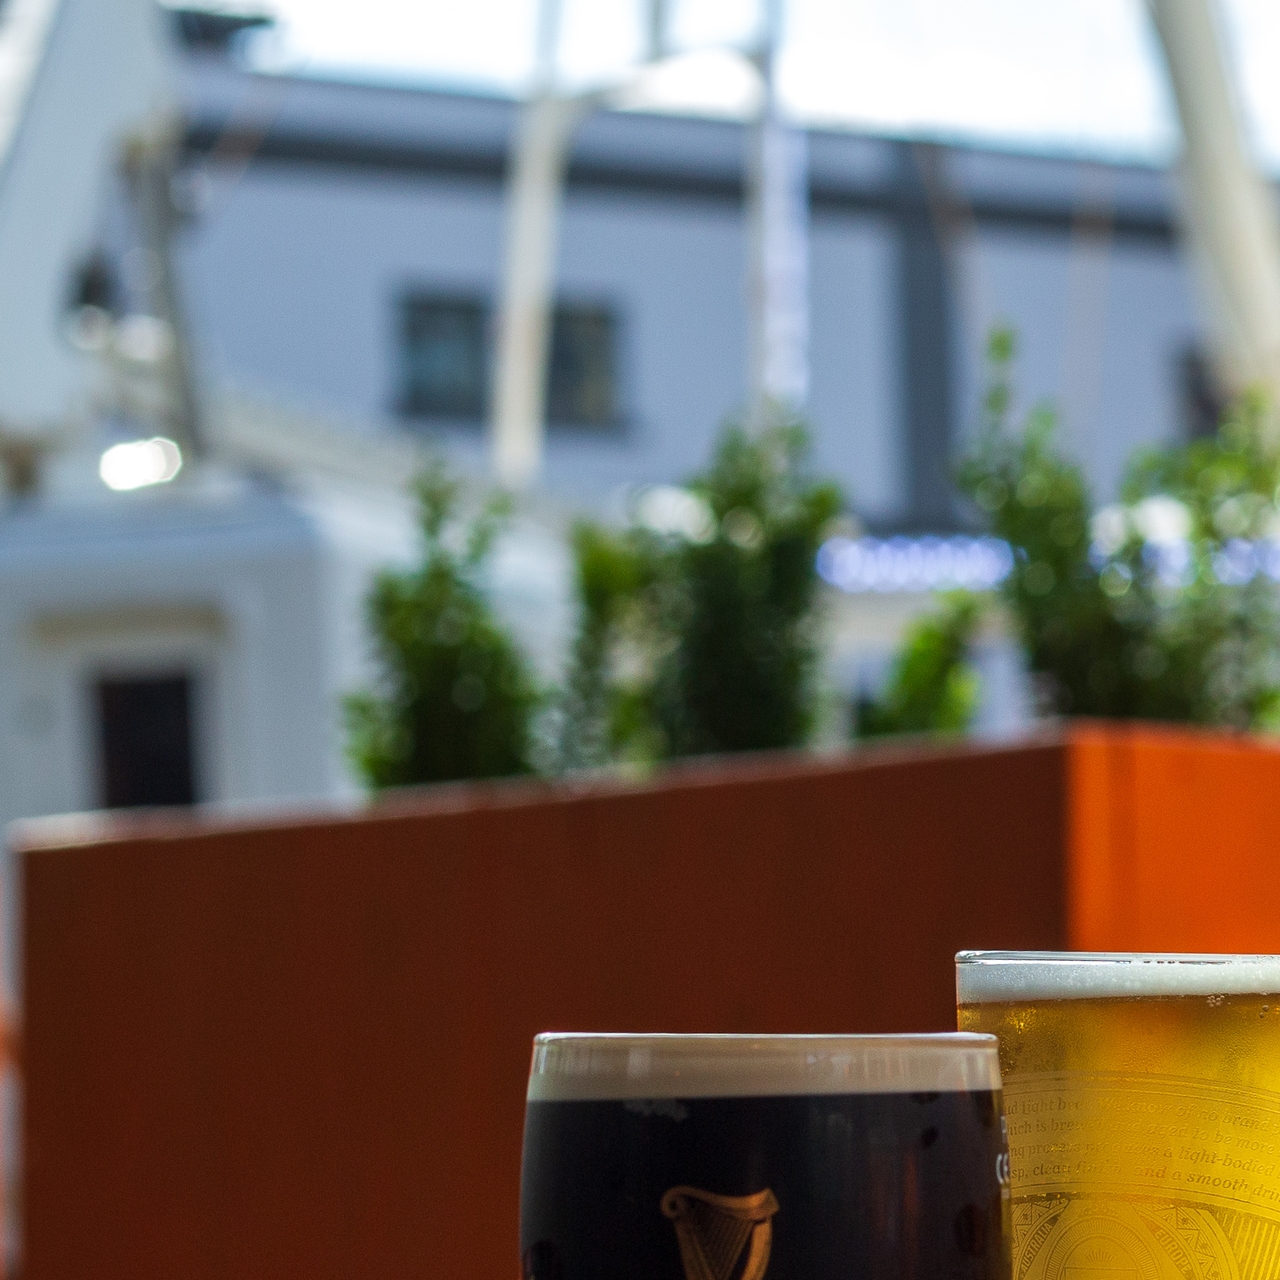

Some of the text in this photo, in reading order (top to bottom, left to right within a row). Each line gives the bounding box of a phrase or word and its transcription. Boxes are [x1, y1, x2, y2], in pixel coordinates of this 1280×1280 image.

[1036, 1119, 1046, 1132] is
[1212, 1128, 1233, 1145] be
[1236, 1136, 1275, 1154] more
[1133, 1165, 1167, 1179] and
[1186, 1171, 1249, 1193] smooth
[1179, 1147, 1276, 1178] light-bodied
[1021, 1222, 1053, 1273] AUSTRALIA
[1154, 1229, 1192, 1275] EUROPE
